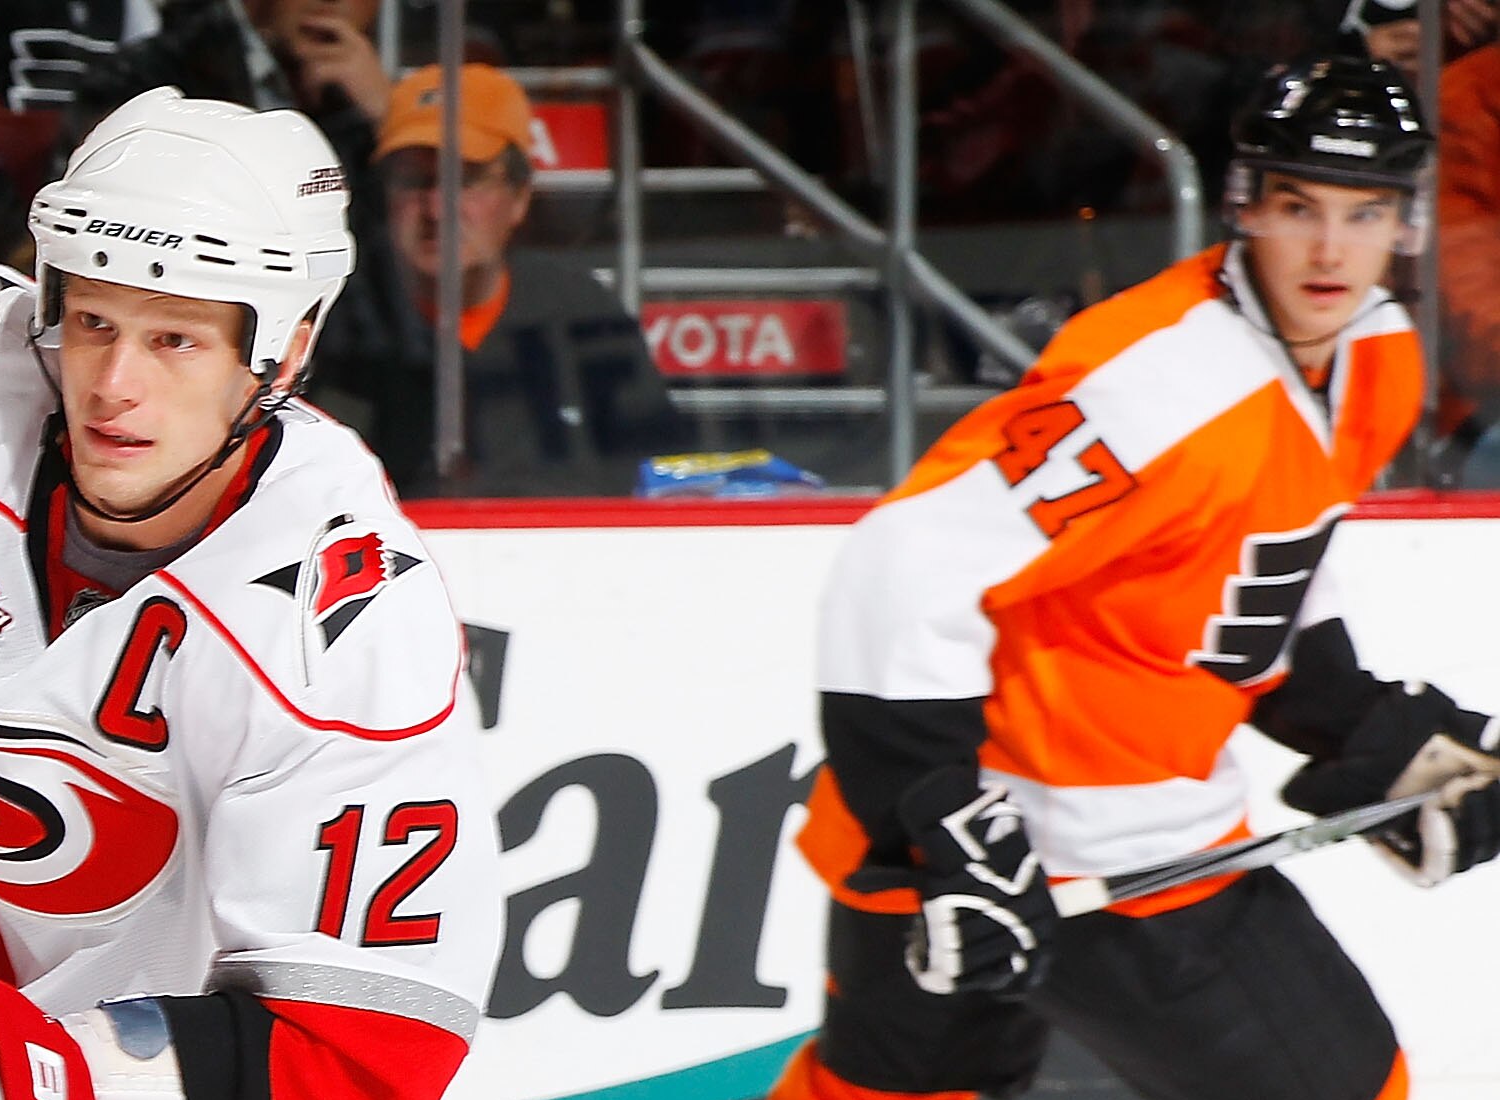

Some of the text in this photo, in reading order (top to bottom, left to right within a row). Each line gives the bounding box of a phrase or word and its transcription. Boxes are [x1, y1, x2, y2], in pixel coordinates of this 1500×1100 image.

[991, 400, 1140, 540] 47
[95, 595, 188, 752] C
[311, 799, 459, 948] 12
